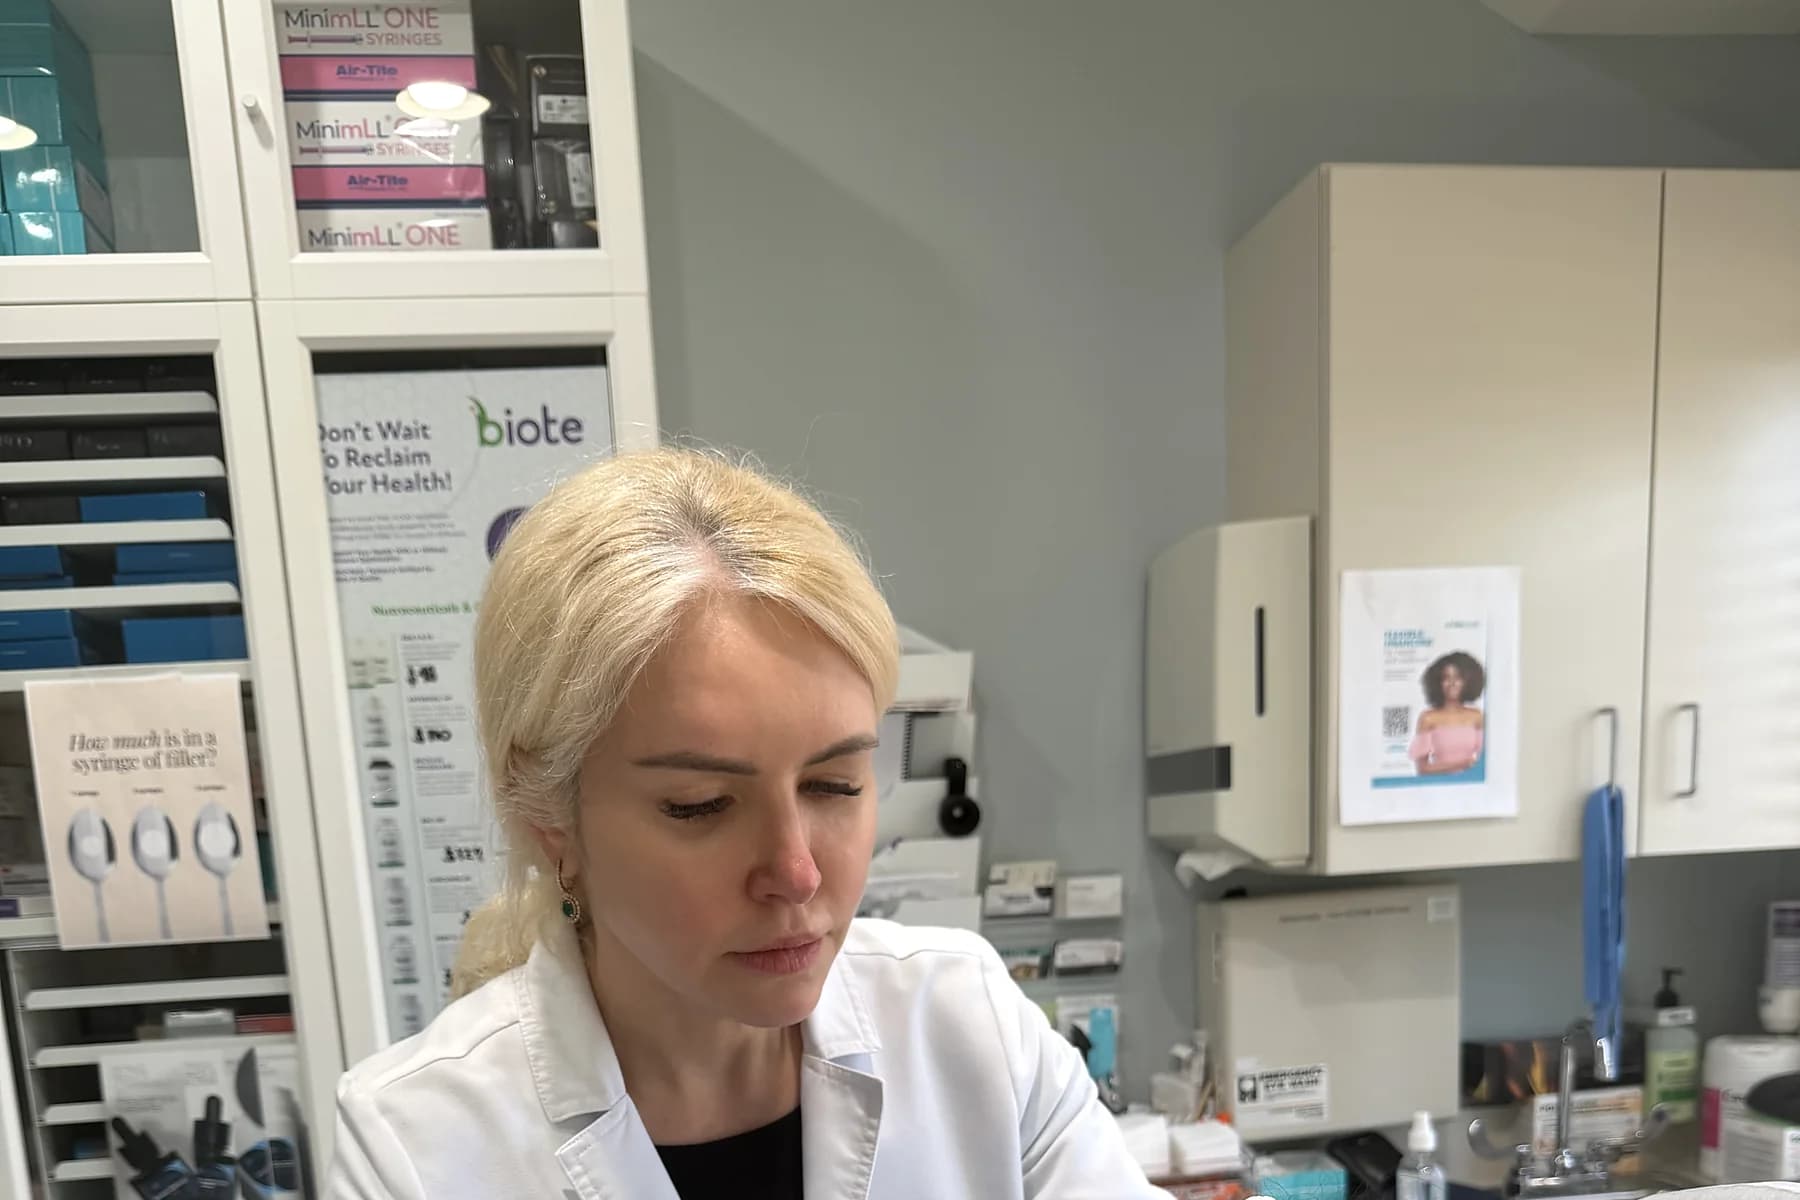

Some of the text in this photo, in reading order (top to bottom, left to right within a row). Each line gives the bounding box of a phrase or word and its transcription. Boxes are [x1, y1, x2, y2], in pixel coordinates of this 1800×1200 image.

[384, 7, 440, 29] ONE
[366, 33, 441, 45] SYRINGES
[406, 224, 461, 246] ONE
[376, 419, 432, 440] Wait
[466, 396, 584, 447] biote
[321, 446, 432, 469] o Reclaim
[324, 470, 452, 495] our Health!
[69, 728, 217, 752] How much is in a
[72, 747, 218, 776] syringe of filler?
